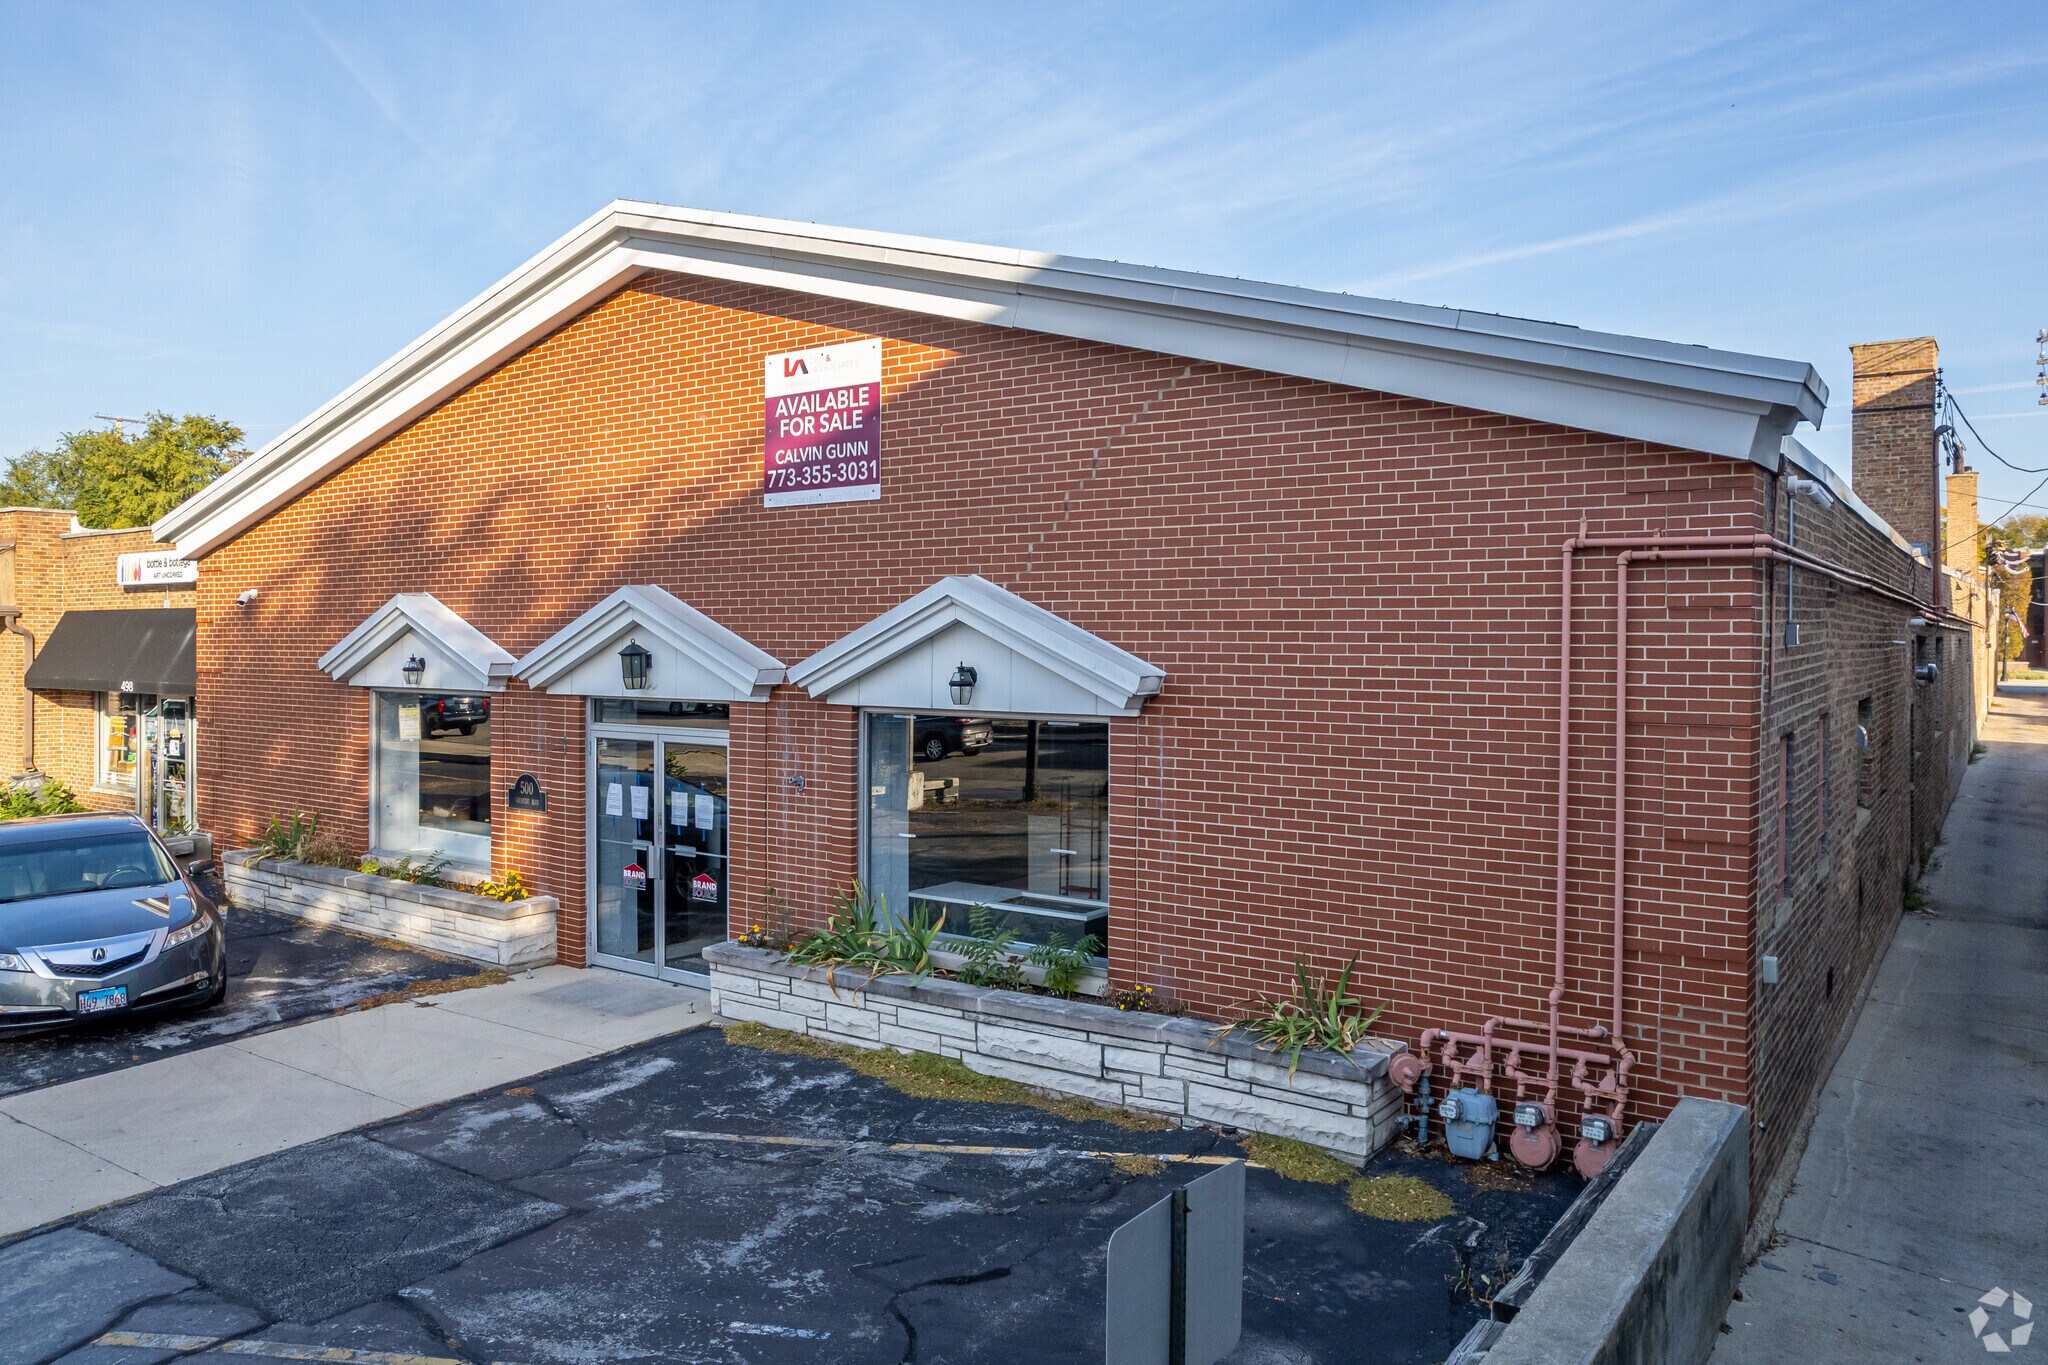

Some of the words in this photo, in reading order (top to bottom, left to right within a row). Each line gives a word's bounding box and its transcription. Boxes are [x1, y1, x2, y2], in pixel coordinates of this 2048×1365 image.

[775, 386, 870, 418] AVAILABLE
[780, 415, 815, 438] FOR
[819, 409, 863, 433] SALE
[775, 445, 823, 465] CALVIN
[826, 440, 869, 459] GUNN
[767, 459, 877, 488] 773-355-3031
[147, 557, 162, 568] bottle
[120, 680, 134, 692] 498
[520, 781, 534, 795] 500
[623, 869, 646, 880] BRAND
[623, 878, 646, 888] SOURCE
[692, 880, 717, 891] BRAND
[692, 888, 718, 900] SOURCE
[104, 993, 126, 1006] 7868
